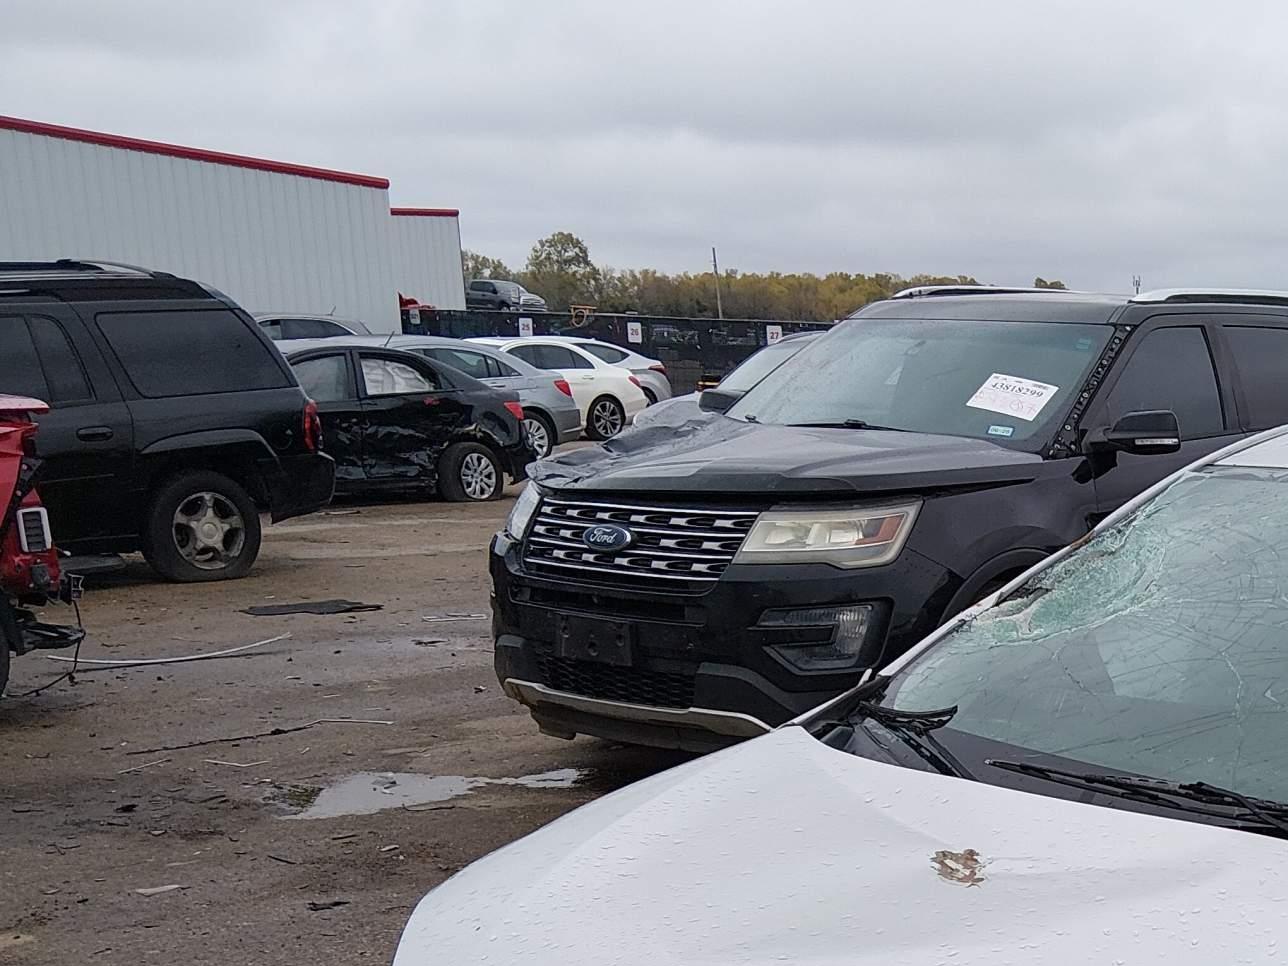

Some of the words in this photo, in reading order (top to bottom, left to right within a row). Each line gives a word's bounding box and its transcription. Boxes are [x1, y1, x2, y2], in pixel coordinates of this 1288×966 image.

[769, 331, 779, 340] 27
[992, 382, 1043, 397] 43818299
[590, 527, 618, 543] Ford
